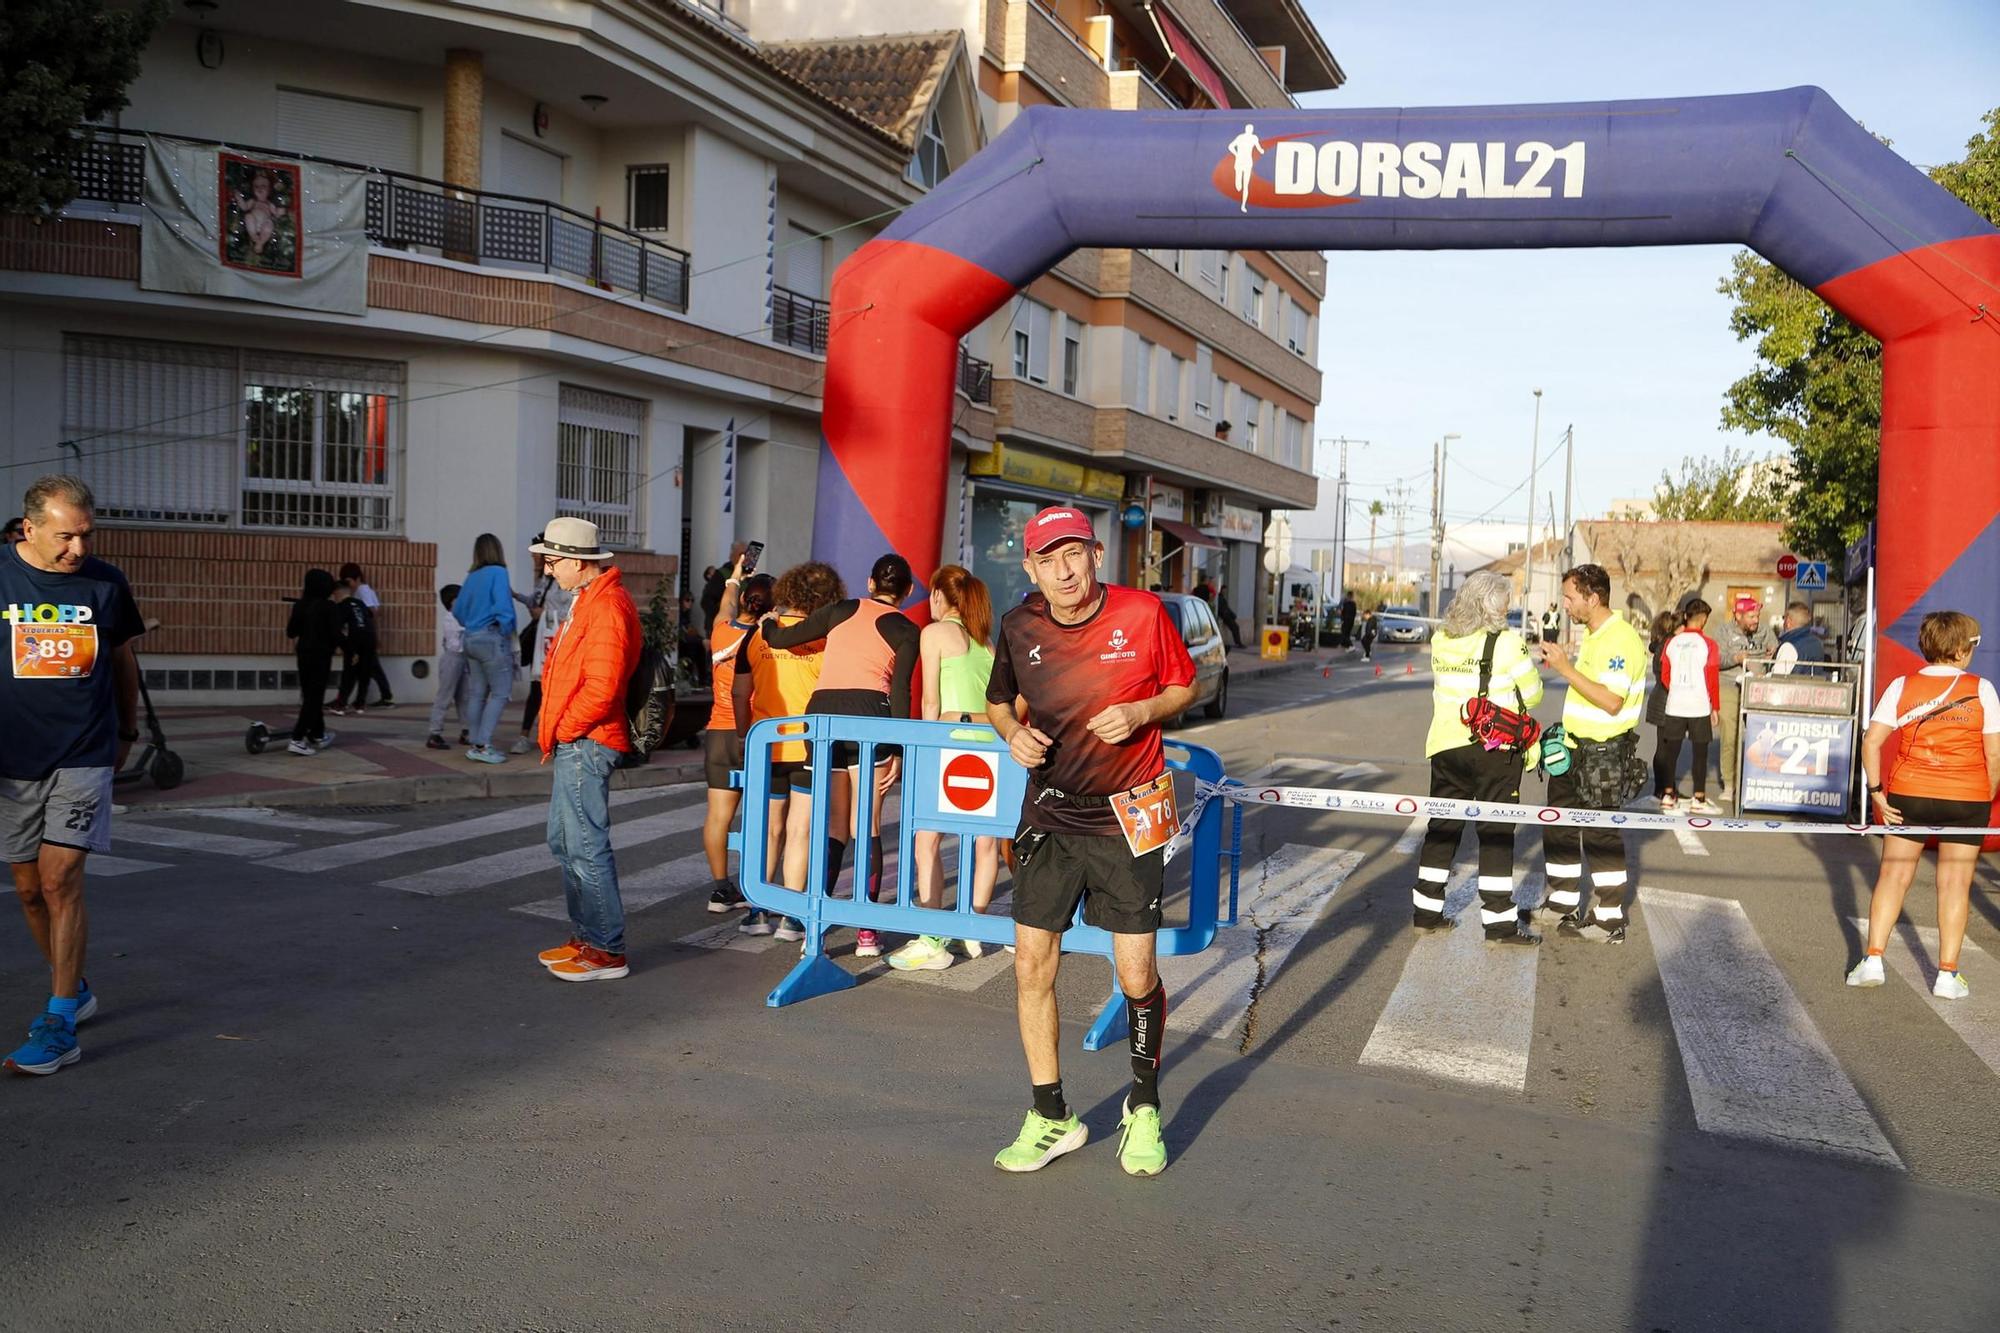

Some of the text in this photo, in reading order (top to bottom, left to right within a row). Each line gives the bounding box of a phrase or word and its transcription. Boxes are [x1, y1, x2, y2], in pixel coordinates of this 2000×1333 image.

[1274, 141, 1586, 199] DORSAL21
[40, 639, 74, 659] 89
[1775, 721, 1841, 738] DORSAL
[1780, 737, 1830, 776] 21
[1351, 799, 1385, 808] ALTO
[1491, 808, 1526, 816] ALTO
